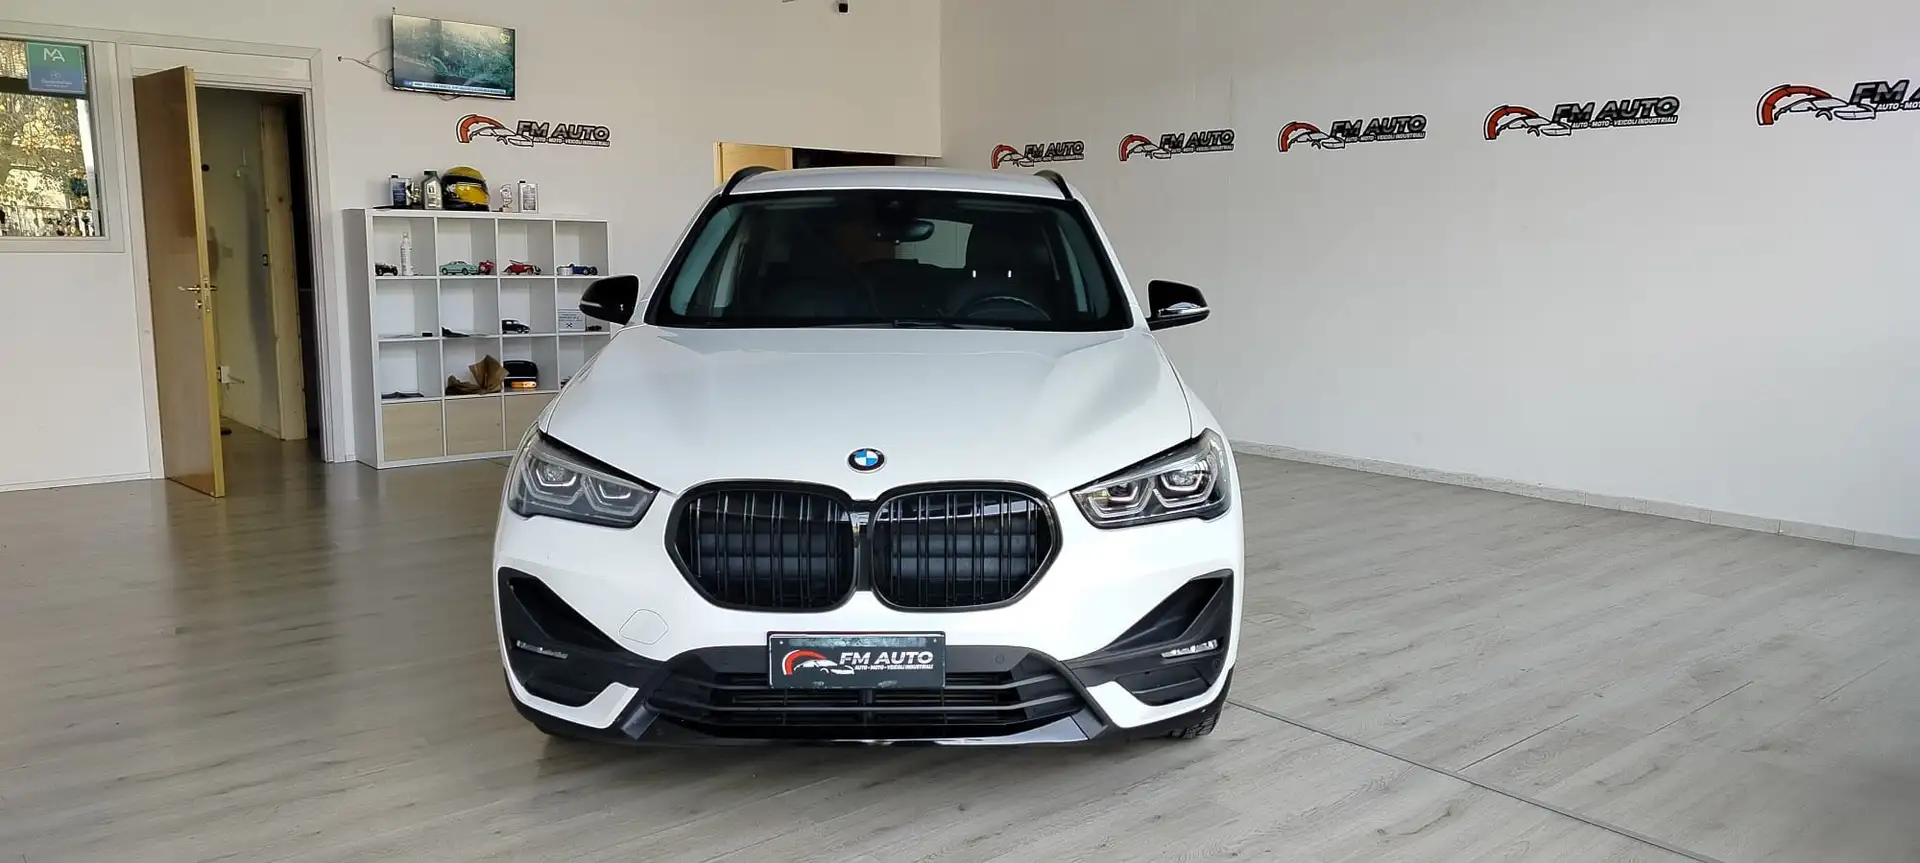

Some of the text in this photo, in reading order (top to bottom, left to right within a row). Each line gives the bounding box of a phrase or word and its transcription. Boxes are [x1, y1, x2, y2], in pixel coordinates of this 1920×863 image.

[1850, 80, 1909, 104] FM
[1552, 96, 1679, 122] FM AUTO
[1904, 101, 1920, 109] MO
[517, 121, 610, 140] FM AUTO
[1330, 115, 1426, 137] FM AUTO
[1160, 130, 1234, 148] FM AUTO
[1024, 144, 1044, 158] FM
[1046, 141, 1084, 156] AUTO
[840, 651, 934, 664] FM AUTO
